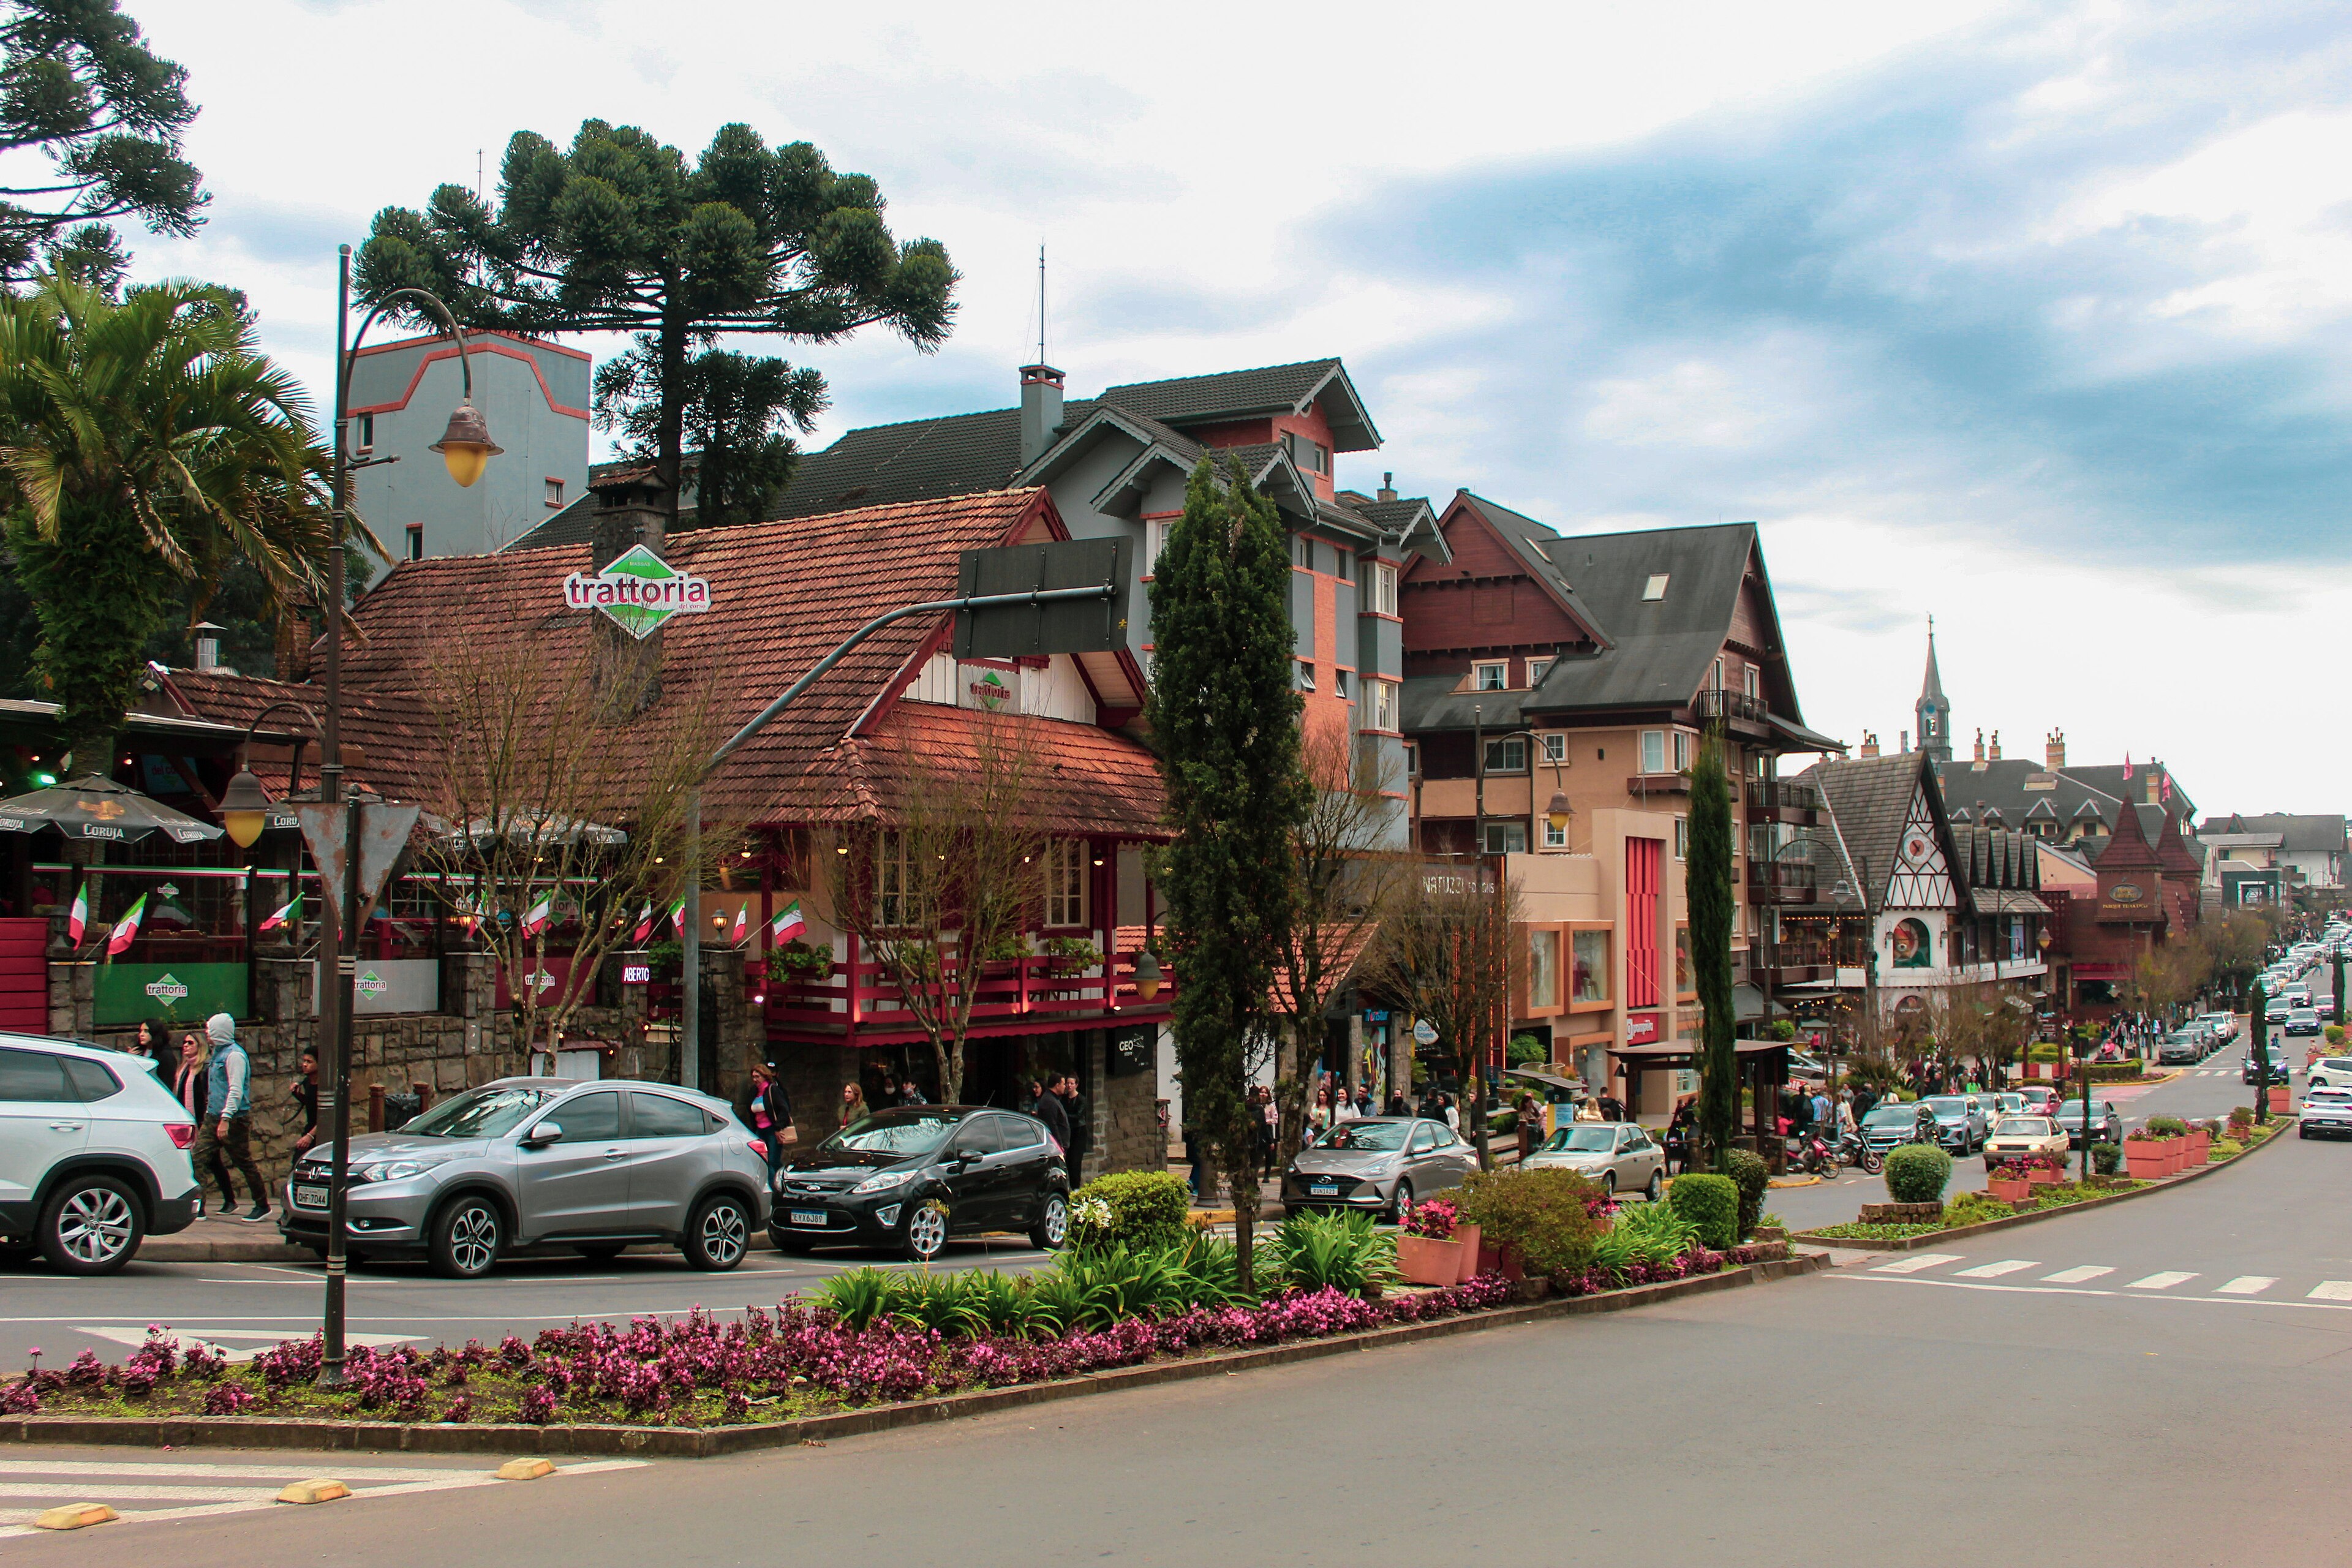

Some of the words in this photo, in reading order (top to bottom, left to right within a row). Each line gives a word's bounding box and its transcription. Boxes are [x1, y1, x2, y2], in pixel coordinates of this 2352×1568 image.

[569, 576, 706, 603] trattoria
[0, 816, 24, 830] ORUJA
[274, 815, 300, 828] CORU
[83, 823, 124, 840] CORUJA
[178, 828, 207, 841] CORUJA
[624, 967, 649, 982] ABERTO
[148, 984, 187, 994] trattoria
[1119, 1040, 1134, 1052] GEO
